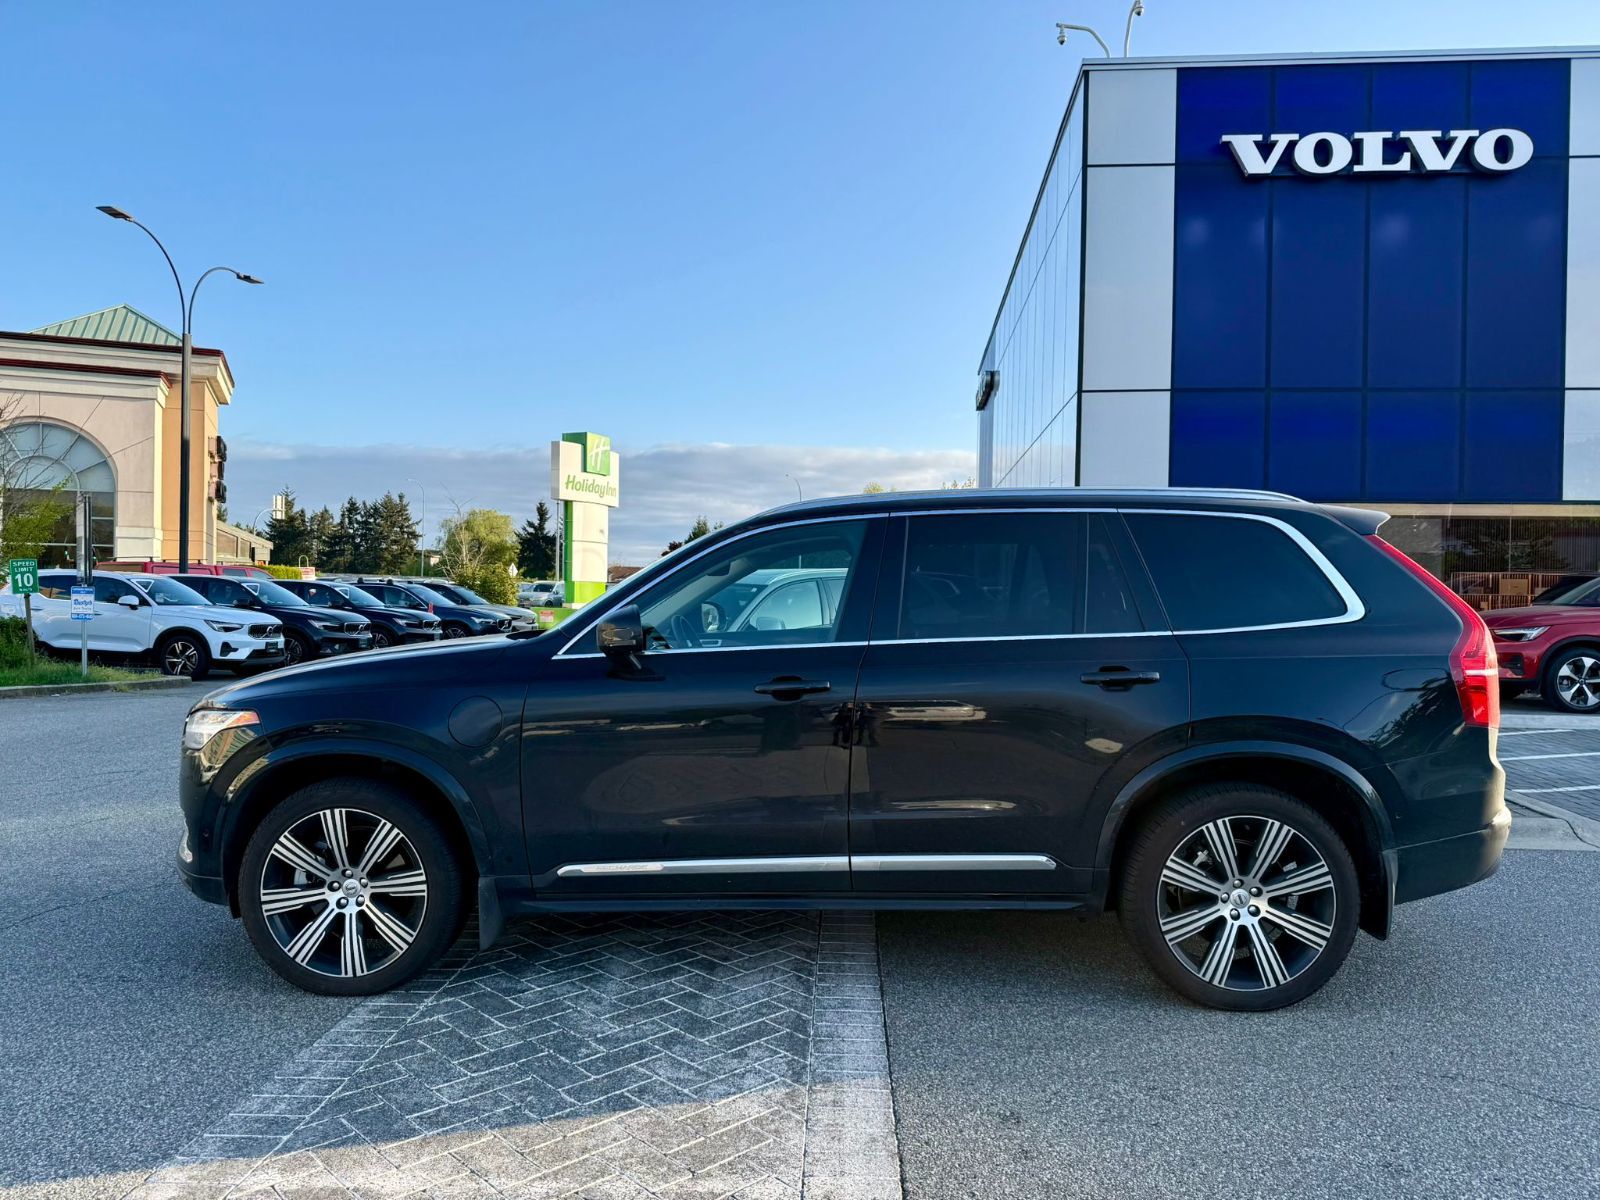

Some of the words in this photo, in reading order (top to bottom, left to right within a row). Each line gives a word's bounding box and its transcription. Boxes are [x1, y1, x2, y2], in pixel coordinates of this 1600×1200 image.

[1220, 128, 1534, 175] VOLVO
[565, 474, 605, 498] Holiday
[606, 481, 617, 498] Inn
[14, 573, 34, 587] 10
